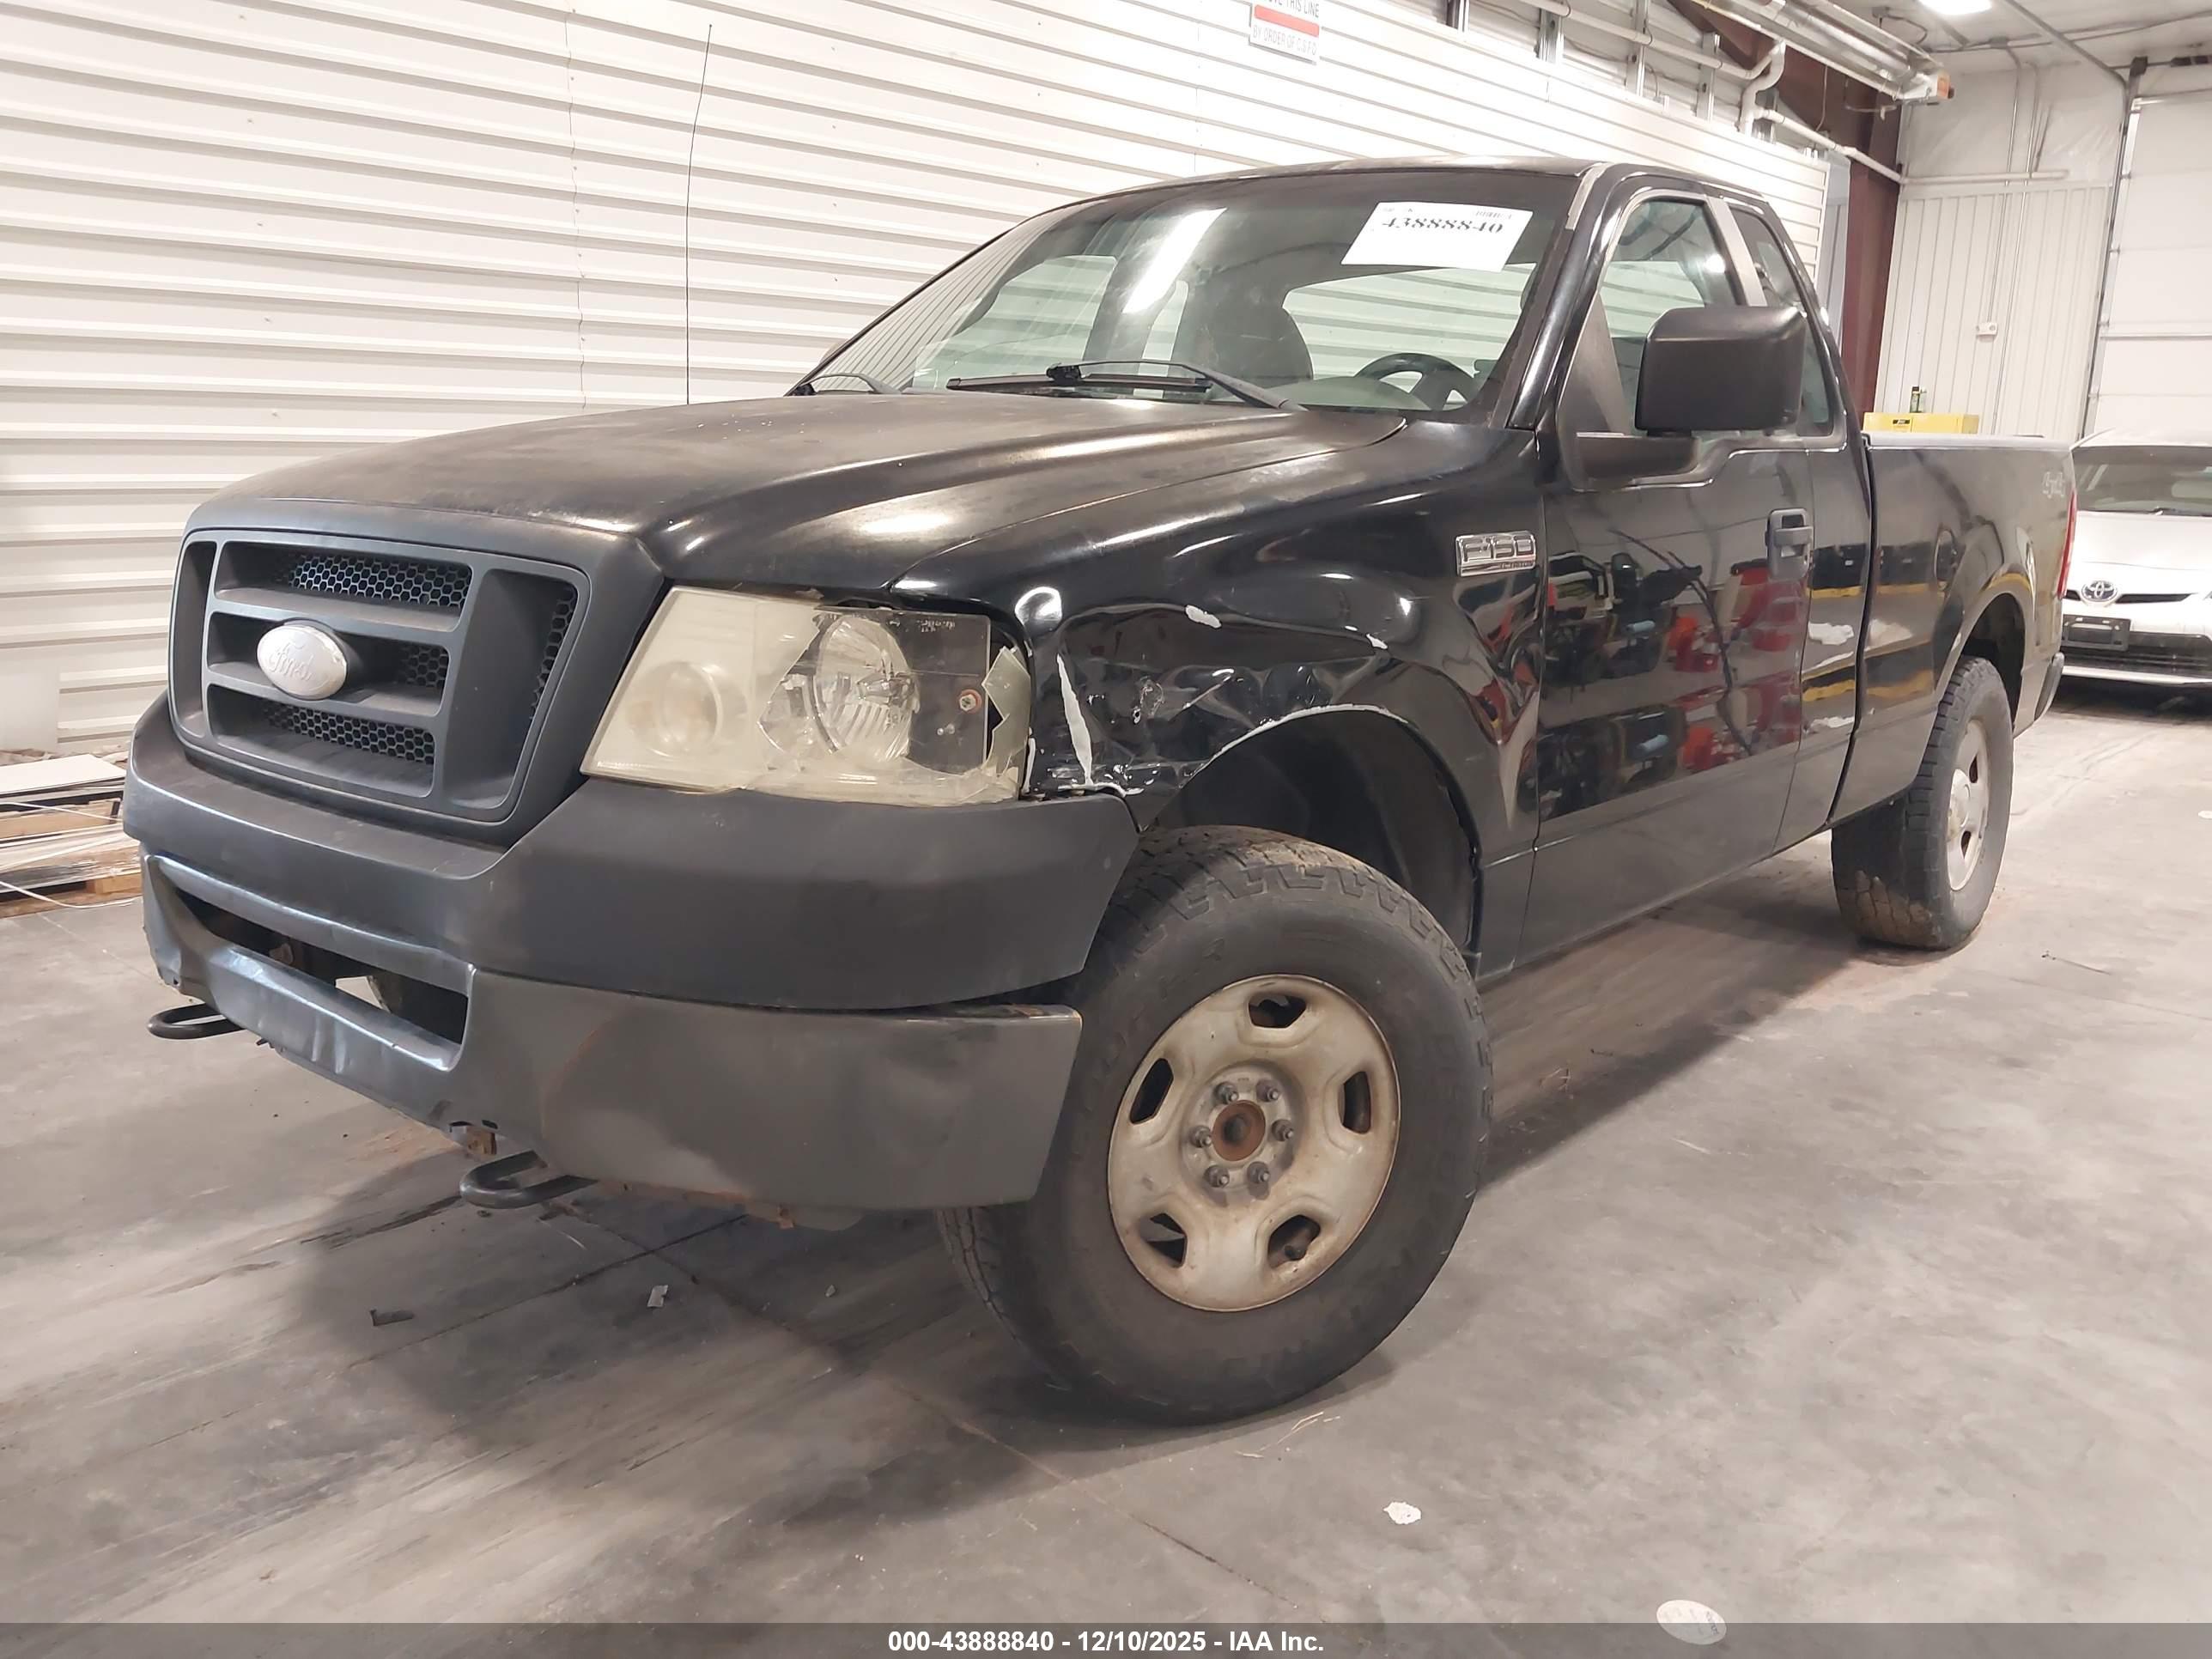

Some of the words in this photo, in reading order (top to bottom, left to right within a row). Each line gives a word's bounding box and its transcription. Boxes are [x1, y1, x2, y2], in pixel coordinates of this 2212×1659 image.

[1304, 2, 1320, 18] LINE
[1253, 24, 1262, 40] BY
[1263, 27, 1285, 46] ORDER
[1381, 216, 1504, 234] 43888840
